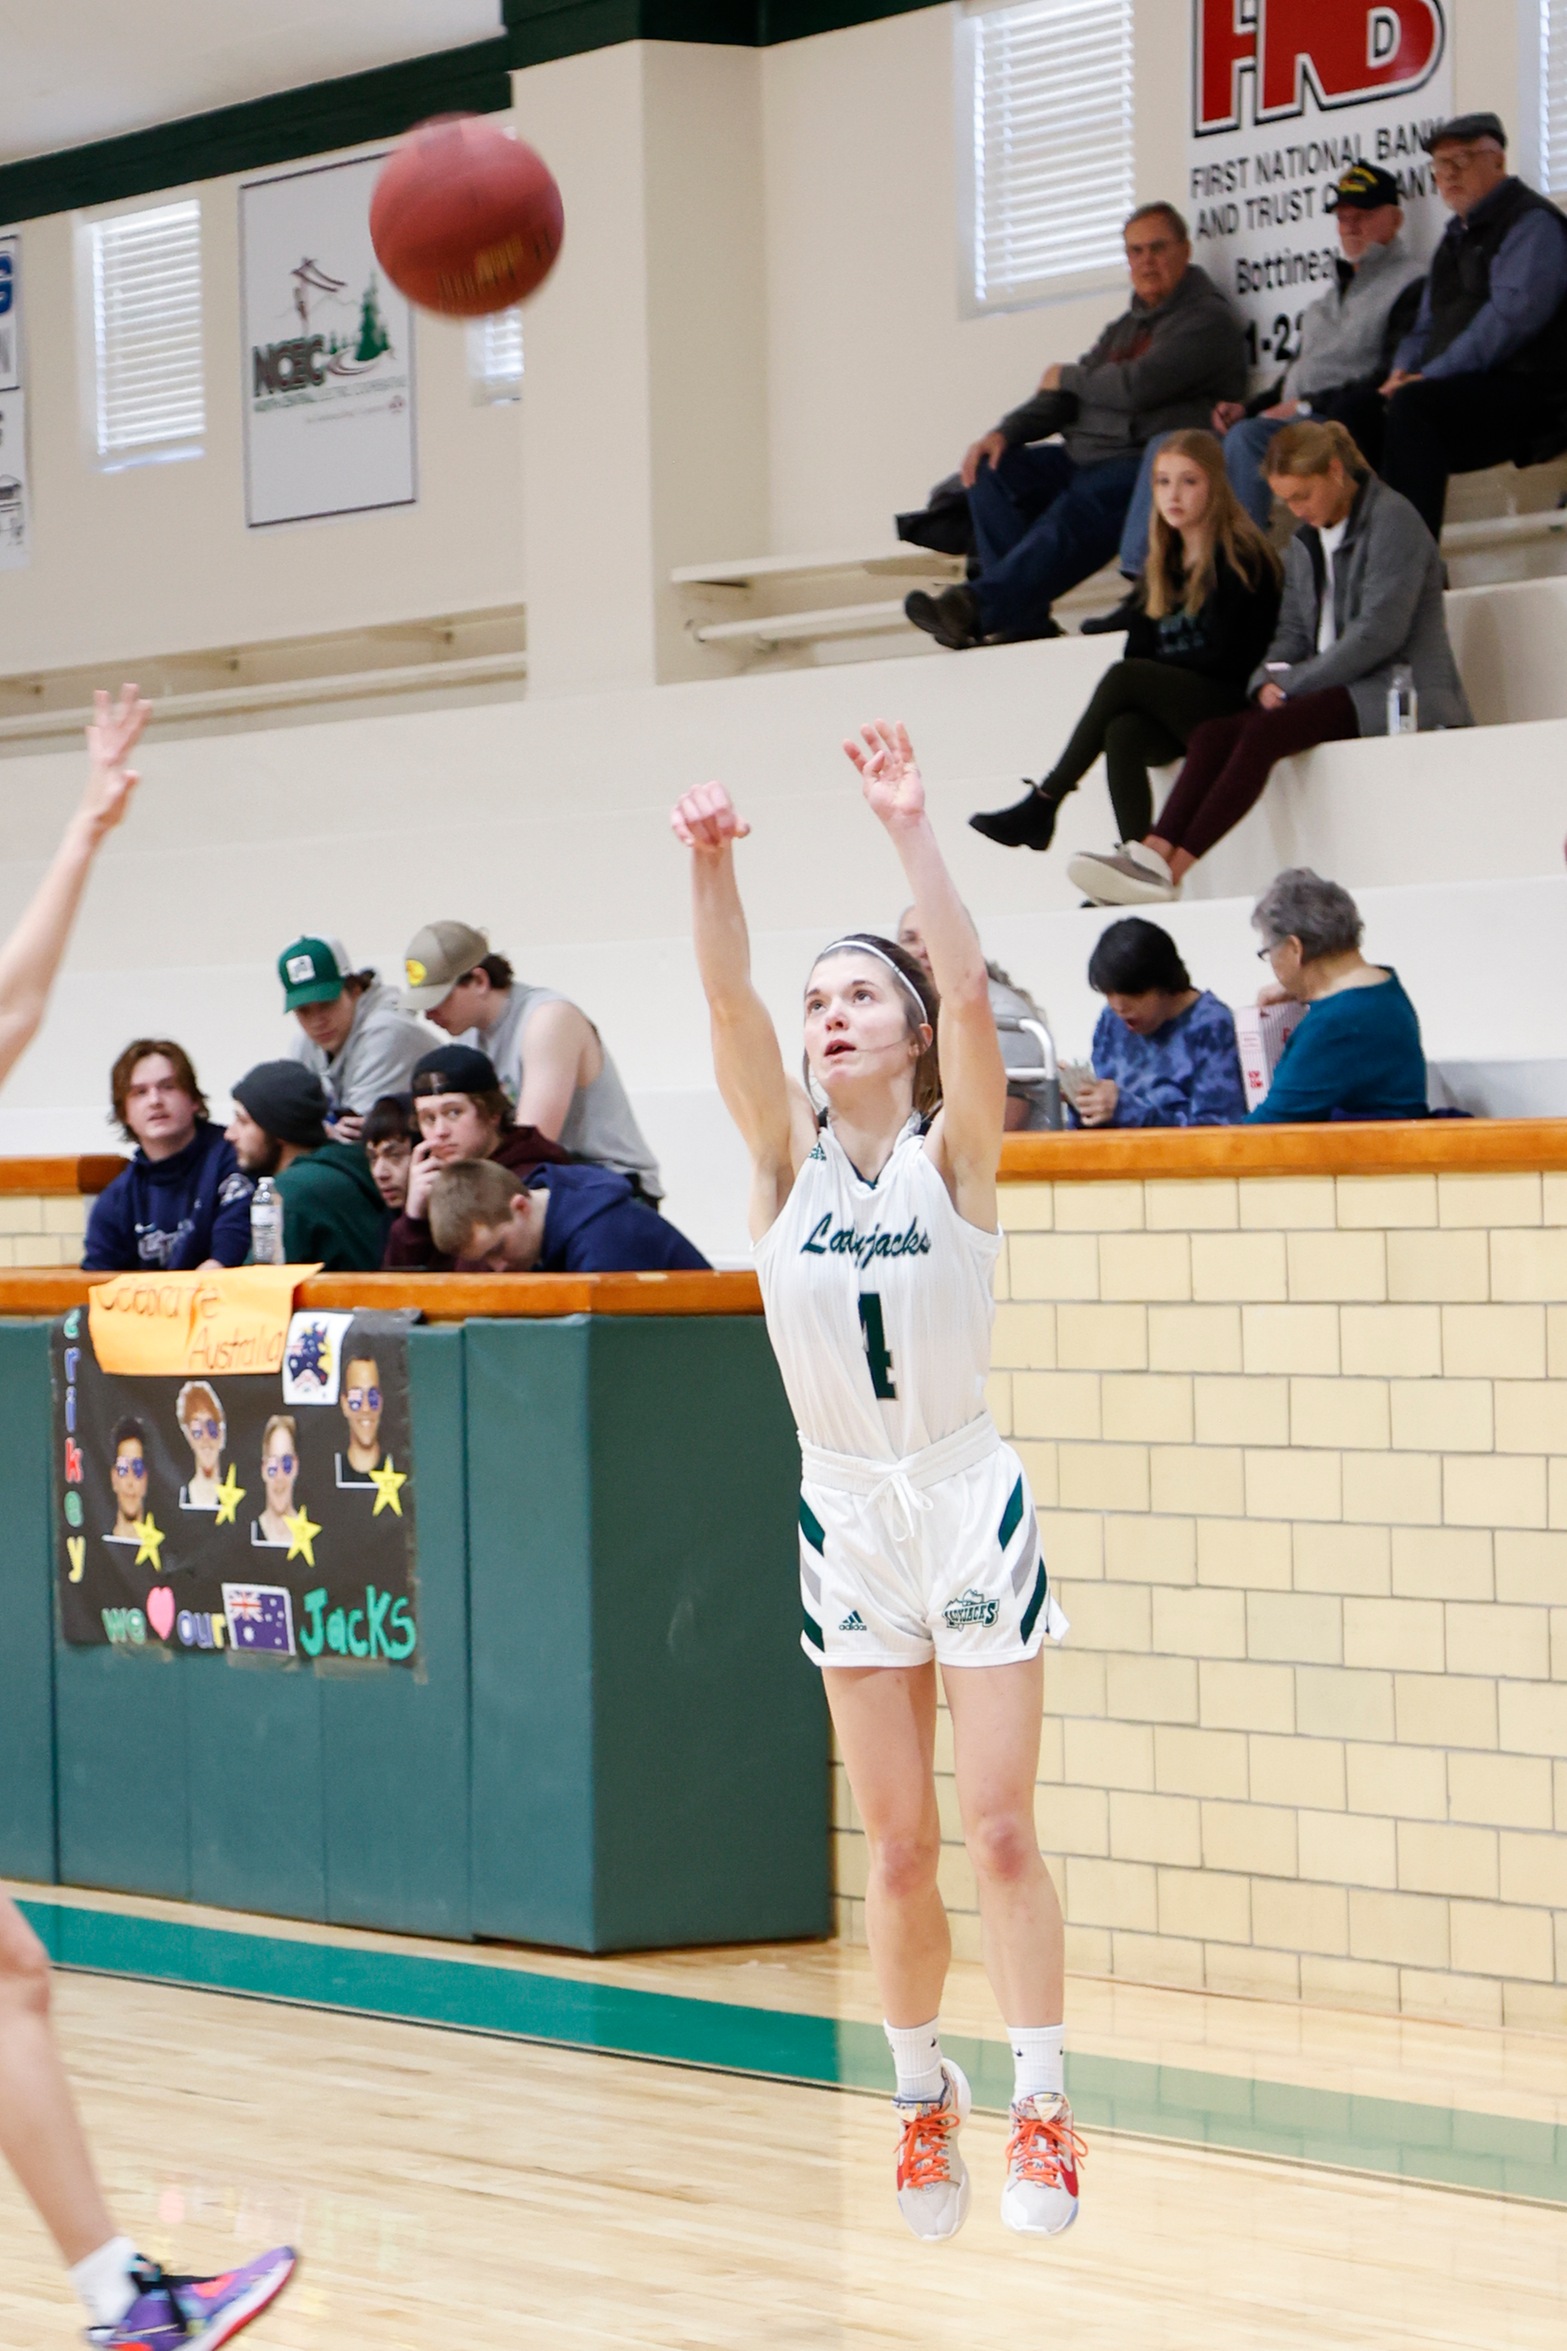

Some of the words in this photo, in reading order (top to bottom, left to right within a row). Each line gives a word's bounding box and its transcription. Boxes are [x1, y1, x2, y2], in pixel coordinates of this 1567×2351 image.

[1190, 158, 1249, 199] FIRST
[1255, 133, 1361, 186] NATIONAL
[1197, 203, 1240, 240] AND
[1244, 187, 1315, 231] TRUST
[252, 334, 325, 398] NCEC
[188, 1324, 285, 1370] Australia
[177, 1609, 227, 1649] our
[839, 1622, 868, 1632] adidas
